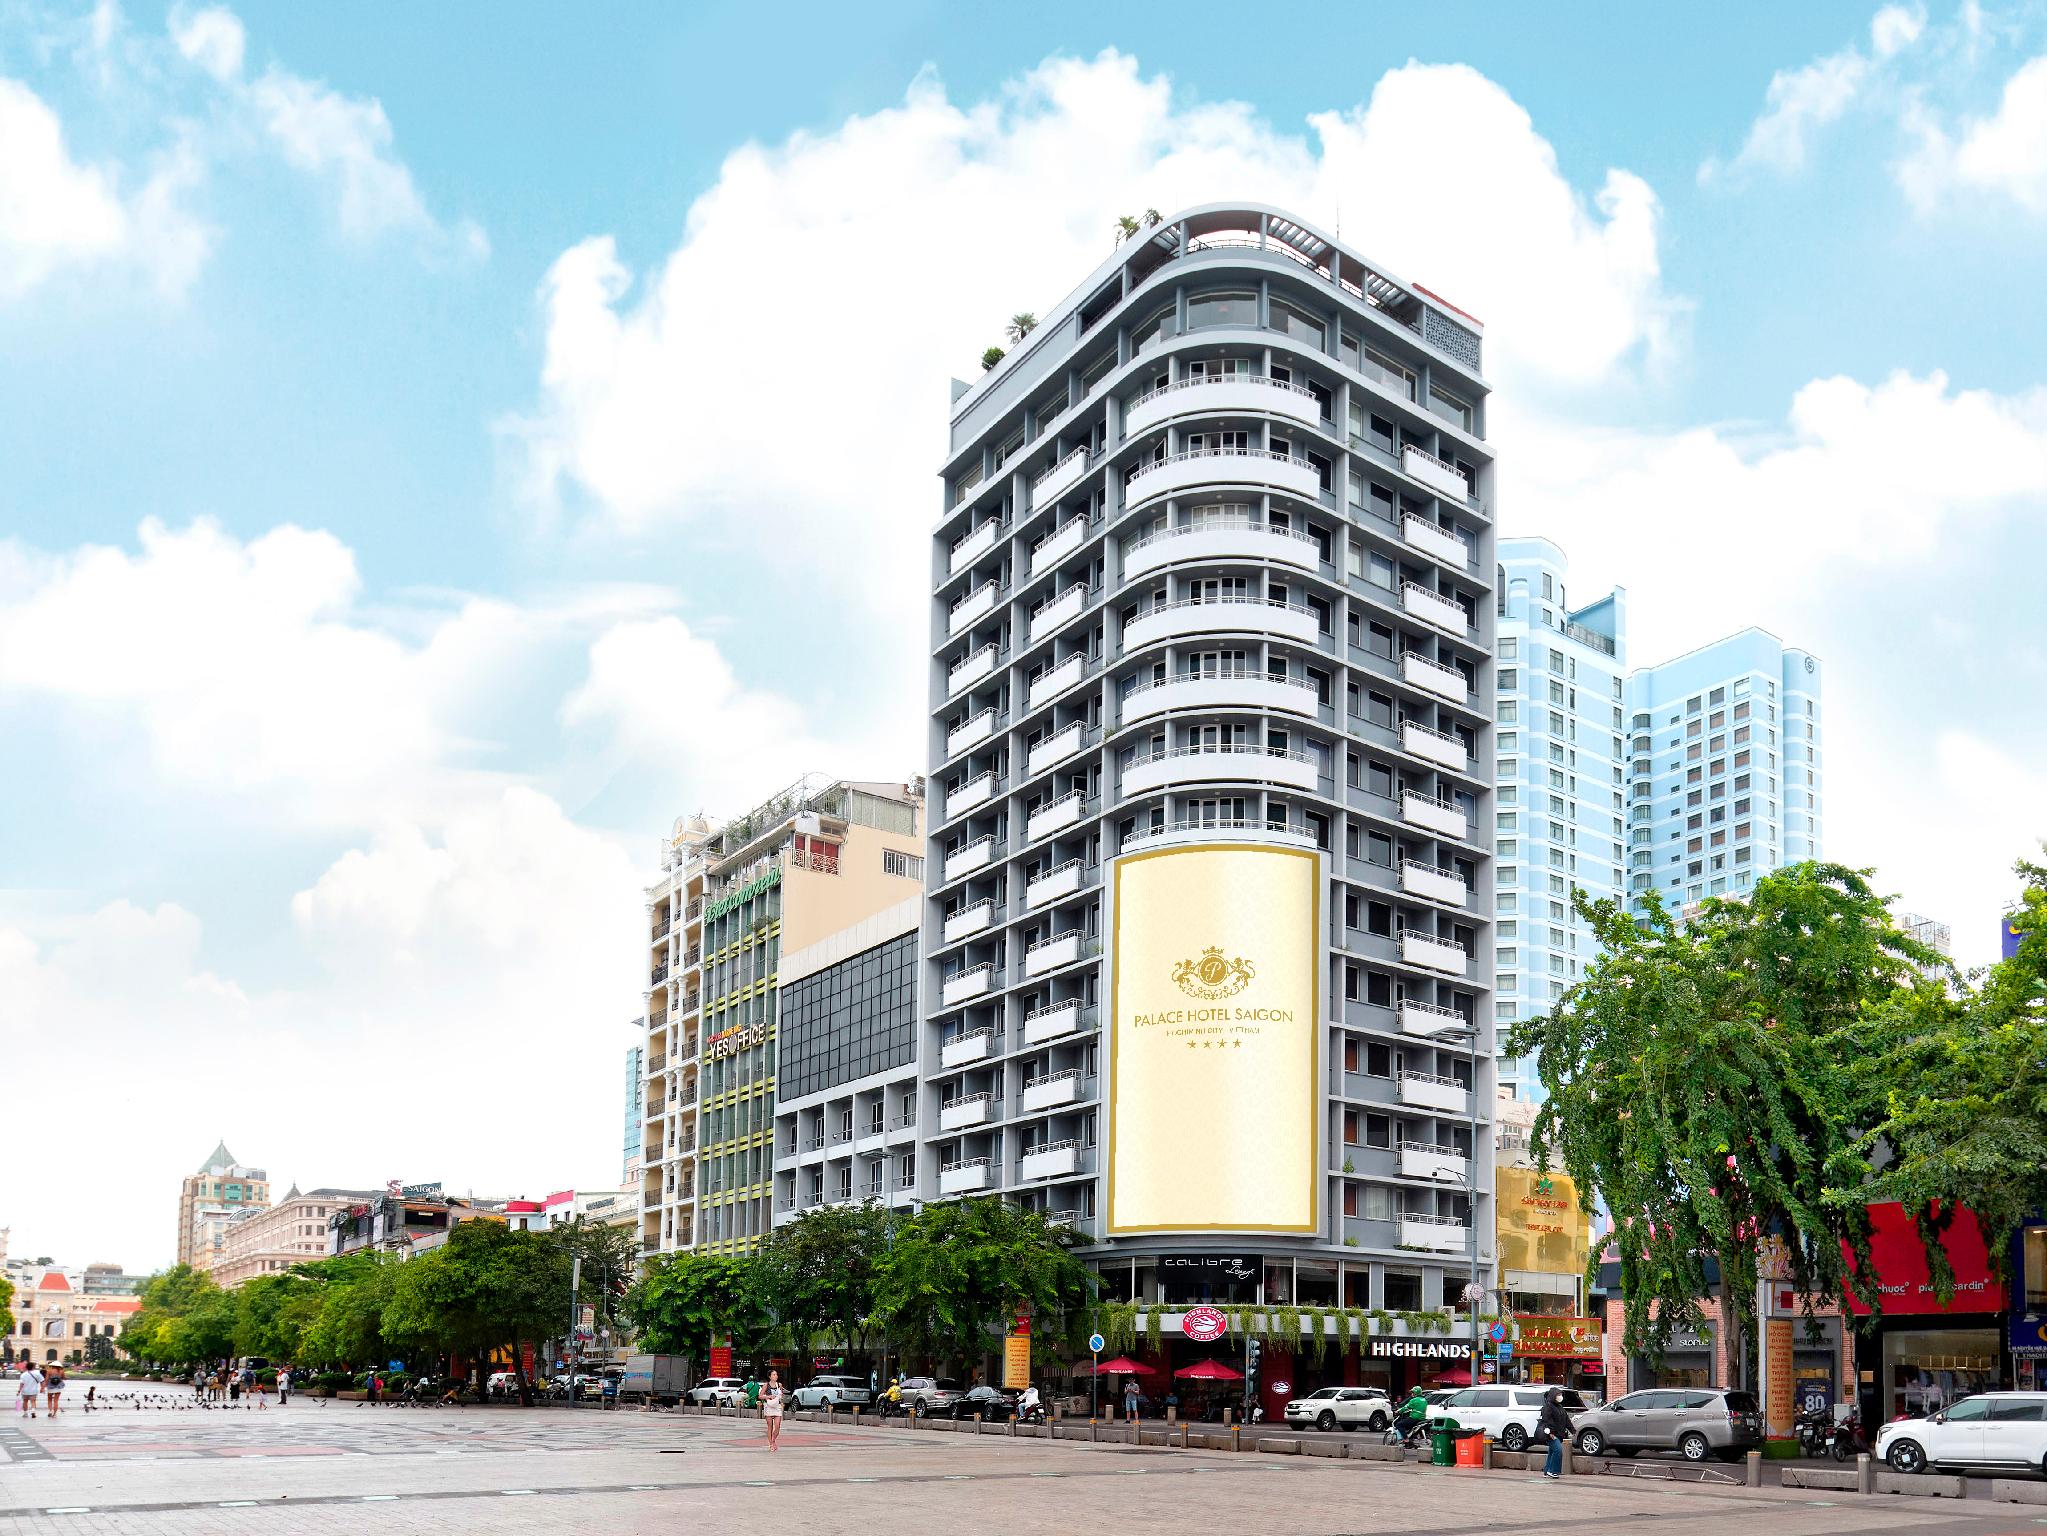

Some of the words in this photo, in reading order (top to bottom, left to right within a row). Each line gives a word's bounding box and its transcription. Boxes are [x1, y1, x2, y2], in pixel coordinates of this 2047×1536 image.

[1134, 1010, 1183, 1028] PALACE
[1187, 1008, 1230, 1022] HOTEL
[1234, 1007, 1293, 1023] SAIGON
[407, 1185, 442, 1193] SAIGON
[1184, 1308, 1225, 1323] HIGHLANDS
[1189, 1331, 1219, 1340] COFFEE
[1372, 1342, 1471, 1358] HIGHLANDS
[1805, 1395, 1825, 1411] 80
